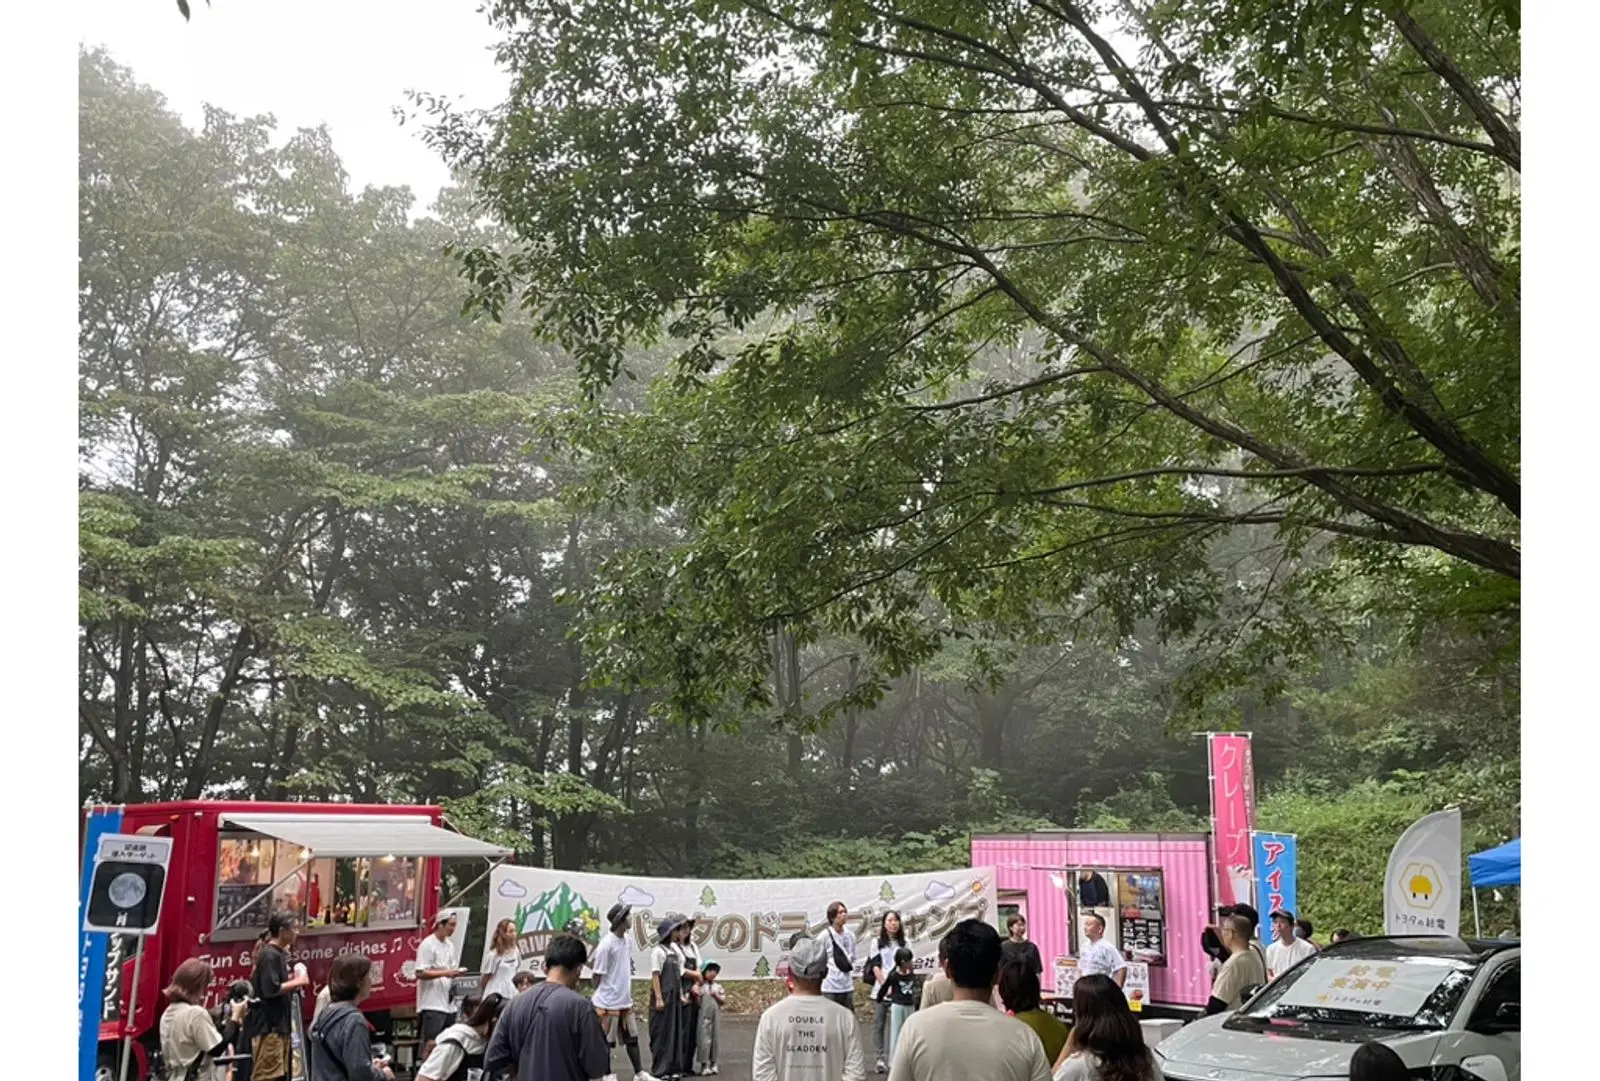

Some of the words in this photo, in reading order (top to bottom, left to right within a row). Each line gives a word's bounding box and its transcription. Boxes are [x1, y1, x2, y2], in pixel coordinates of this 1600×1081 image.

[1220, 743, 1247, 860] クレープ
[788, 1015, 824, 1024] DOUBLE
[797, 1030, 815, 1038] THE
